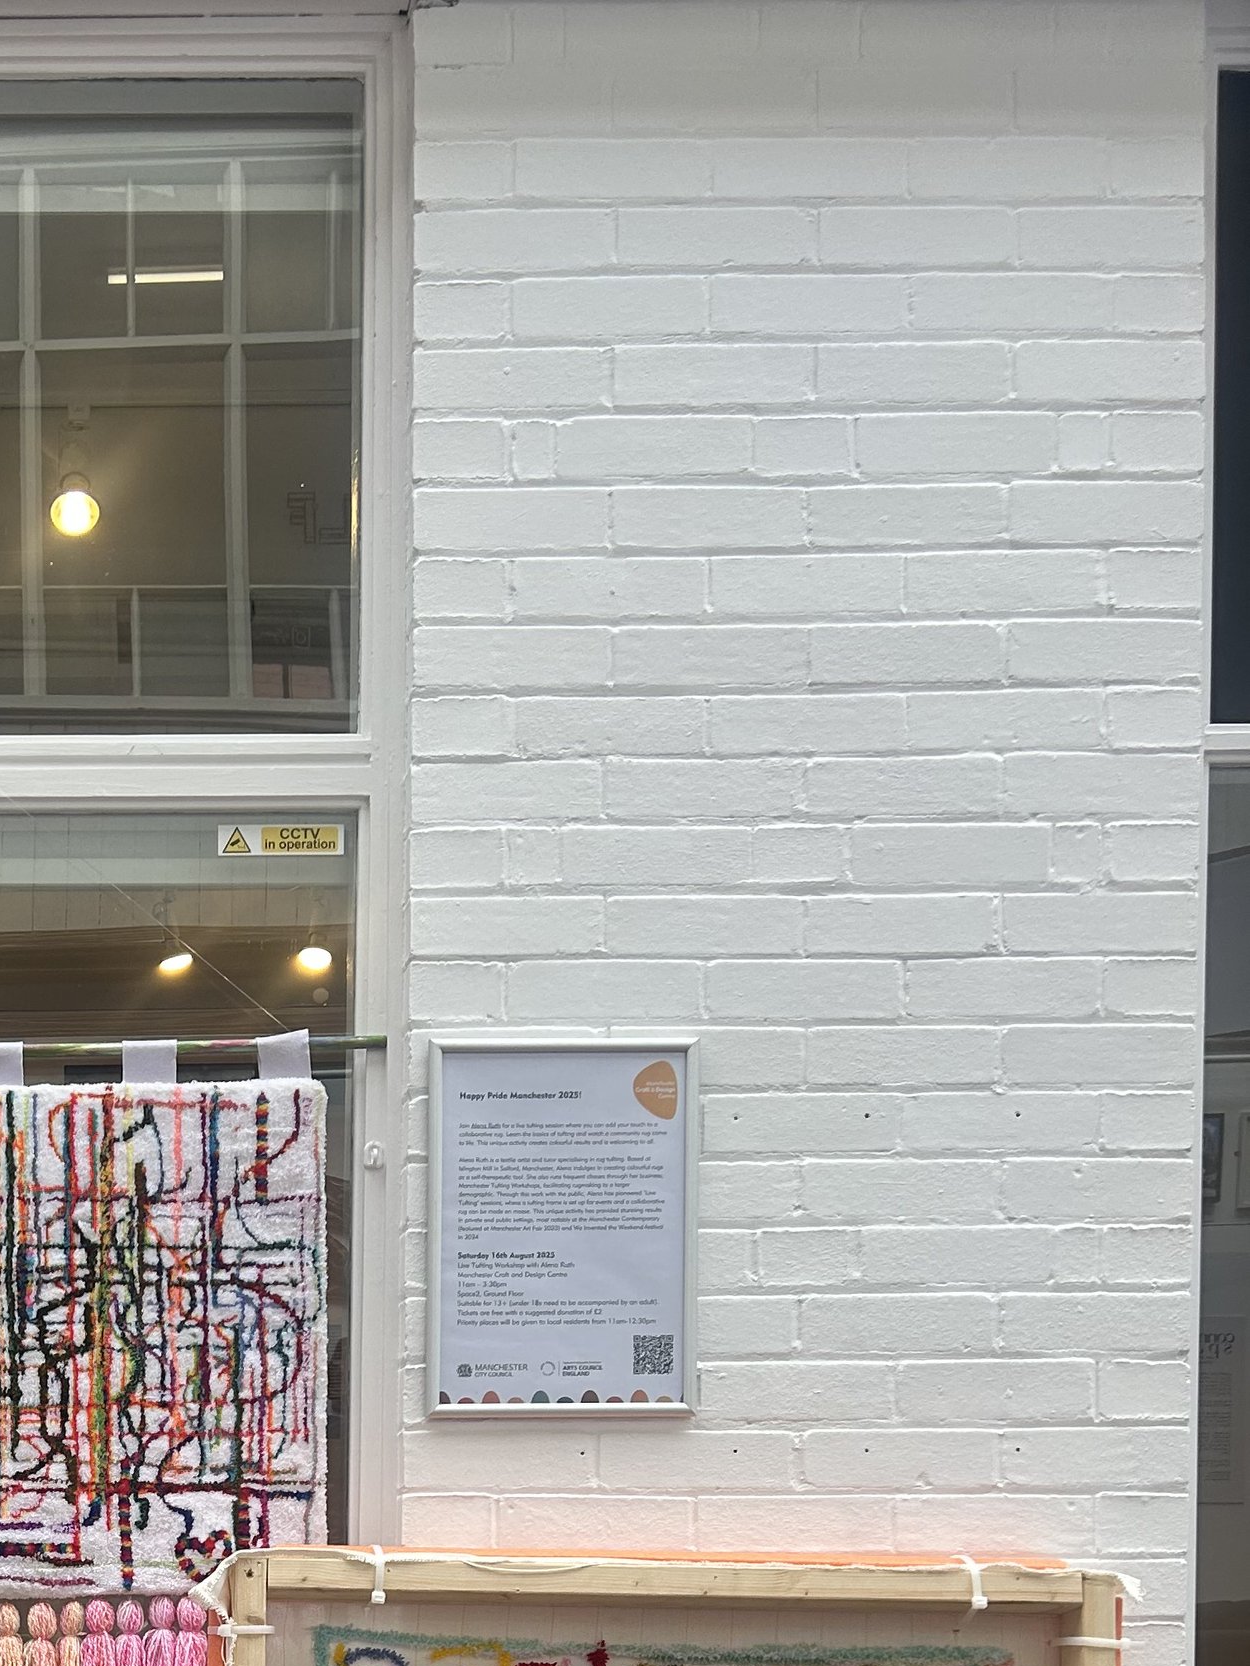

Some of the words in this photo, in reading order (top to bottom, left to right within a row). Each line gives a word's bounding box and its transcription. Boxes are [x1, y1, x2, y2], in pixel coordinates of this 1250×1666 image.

[280, 828, 320, 840] CCTV
[264, 838, 276, 849] in
[278, 838, 336, 851] operation
[459, 1092, 485, 1101] Happy
[487, 1091, 507, 1099] Pride
[510, 1091, 556, 1099] Manchester
[558, 1091, 582, 1099] 2025!
[457, 1252, 489, 1260] Saturday
[509, 1252, 534, 1260] August
